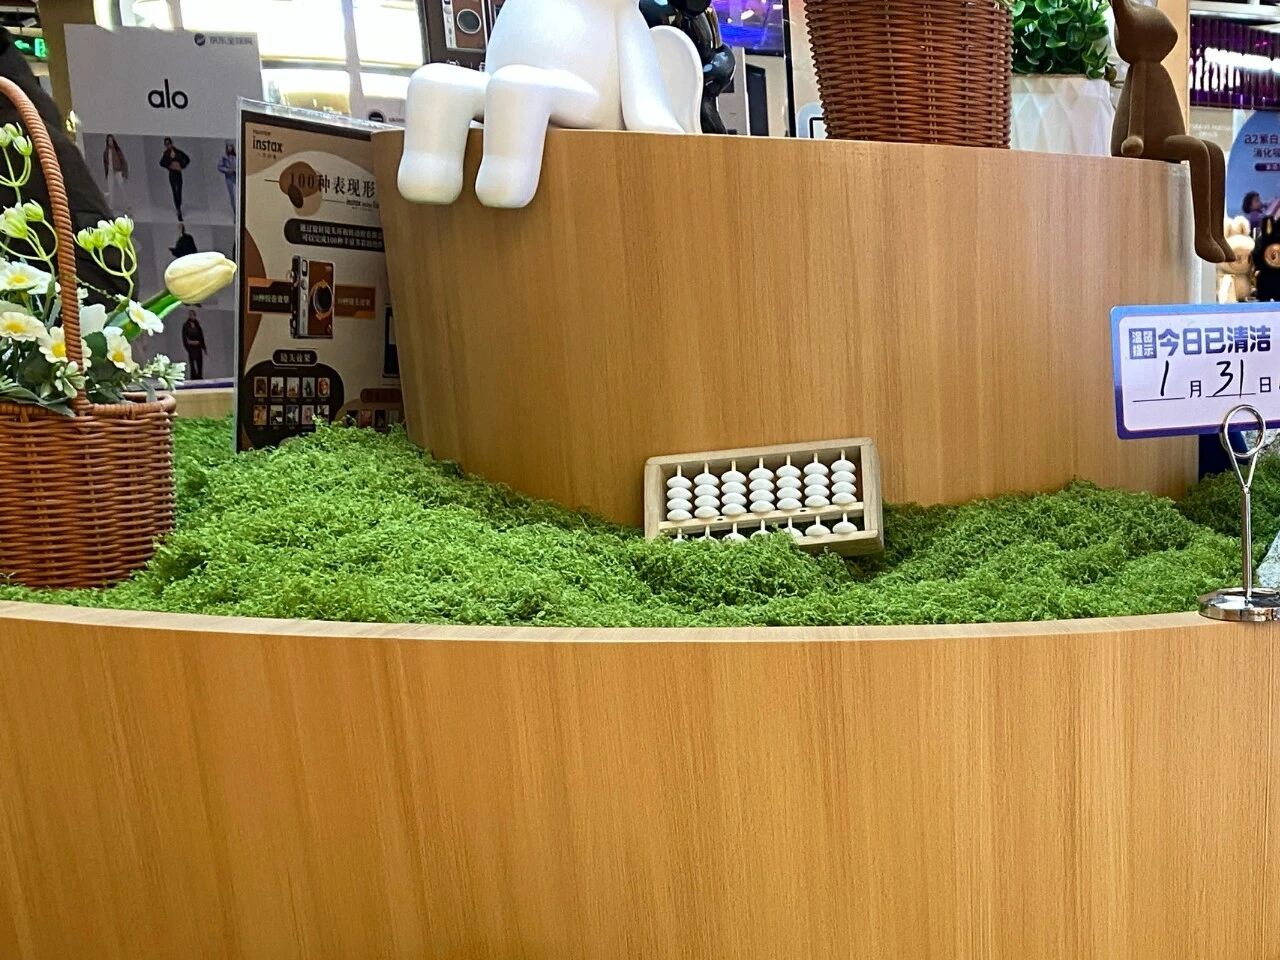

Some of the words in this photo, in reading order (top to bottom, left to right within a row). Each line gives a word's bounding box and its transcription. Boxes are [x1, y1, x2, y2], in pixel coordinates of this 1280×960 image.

[147, 79, 188, 109] alo
[252, 135, 283, 153] instax
[1158, 325, 1271, 356] 今日已清洁
[1160, 360, 1169, 397] 1
[1190, 380, 1201, 398] 月
[1211, 359, 1244, 398] 31
[1259, 377, 1271, 393] 日
